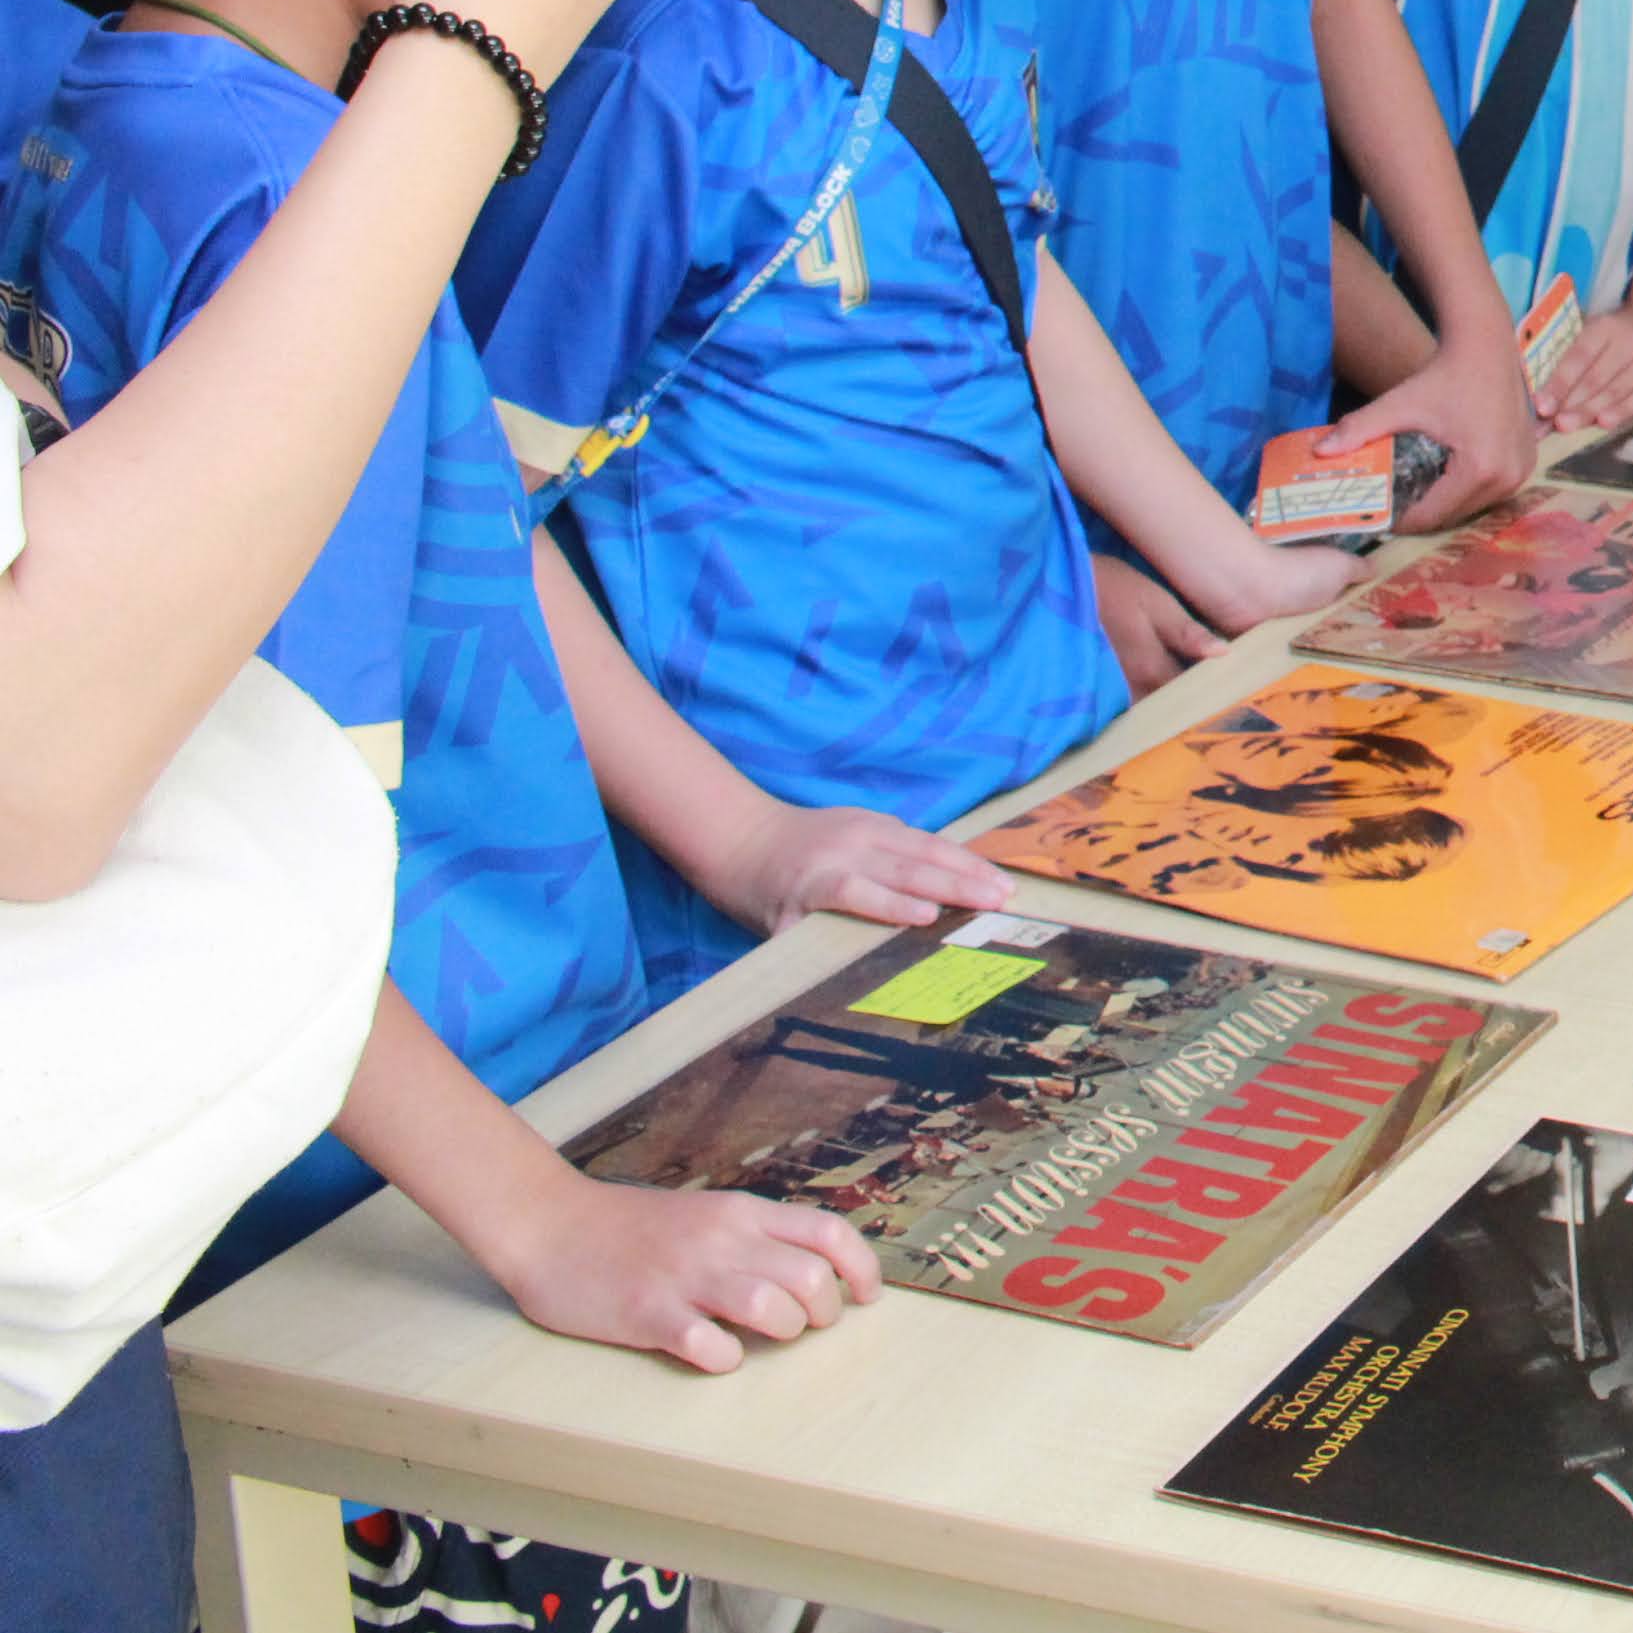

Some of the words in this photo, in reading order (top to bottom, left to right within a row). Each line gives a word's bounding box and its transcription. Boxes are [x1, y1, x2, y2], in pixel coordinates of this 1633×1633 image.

[789, 163, 860, 237] BLOCK
[1000, 992, 1493, 1331] SINATRA'S
[1299, 1344, 1406, 1432] ORCHESTRA
[1321, 1335, 1375, 1371] MAX
[1374, 1307, 1474, 1391] CINCINNATI
[1285, 1392, 1394, 1484] SYMPHONY
